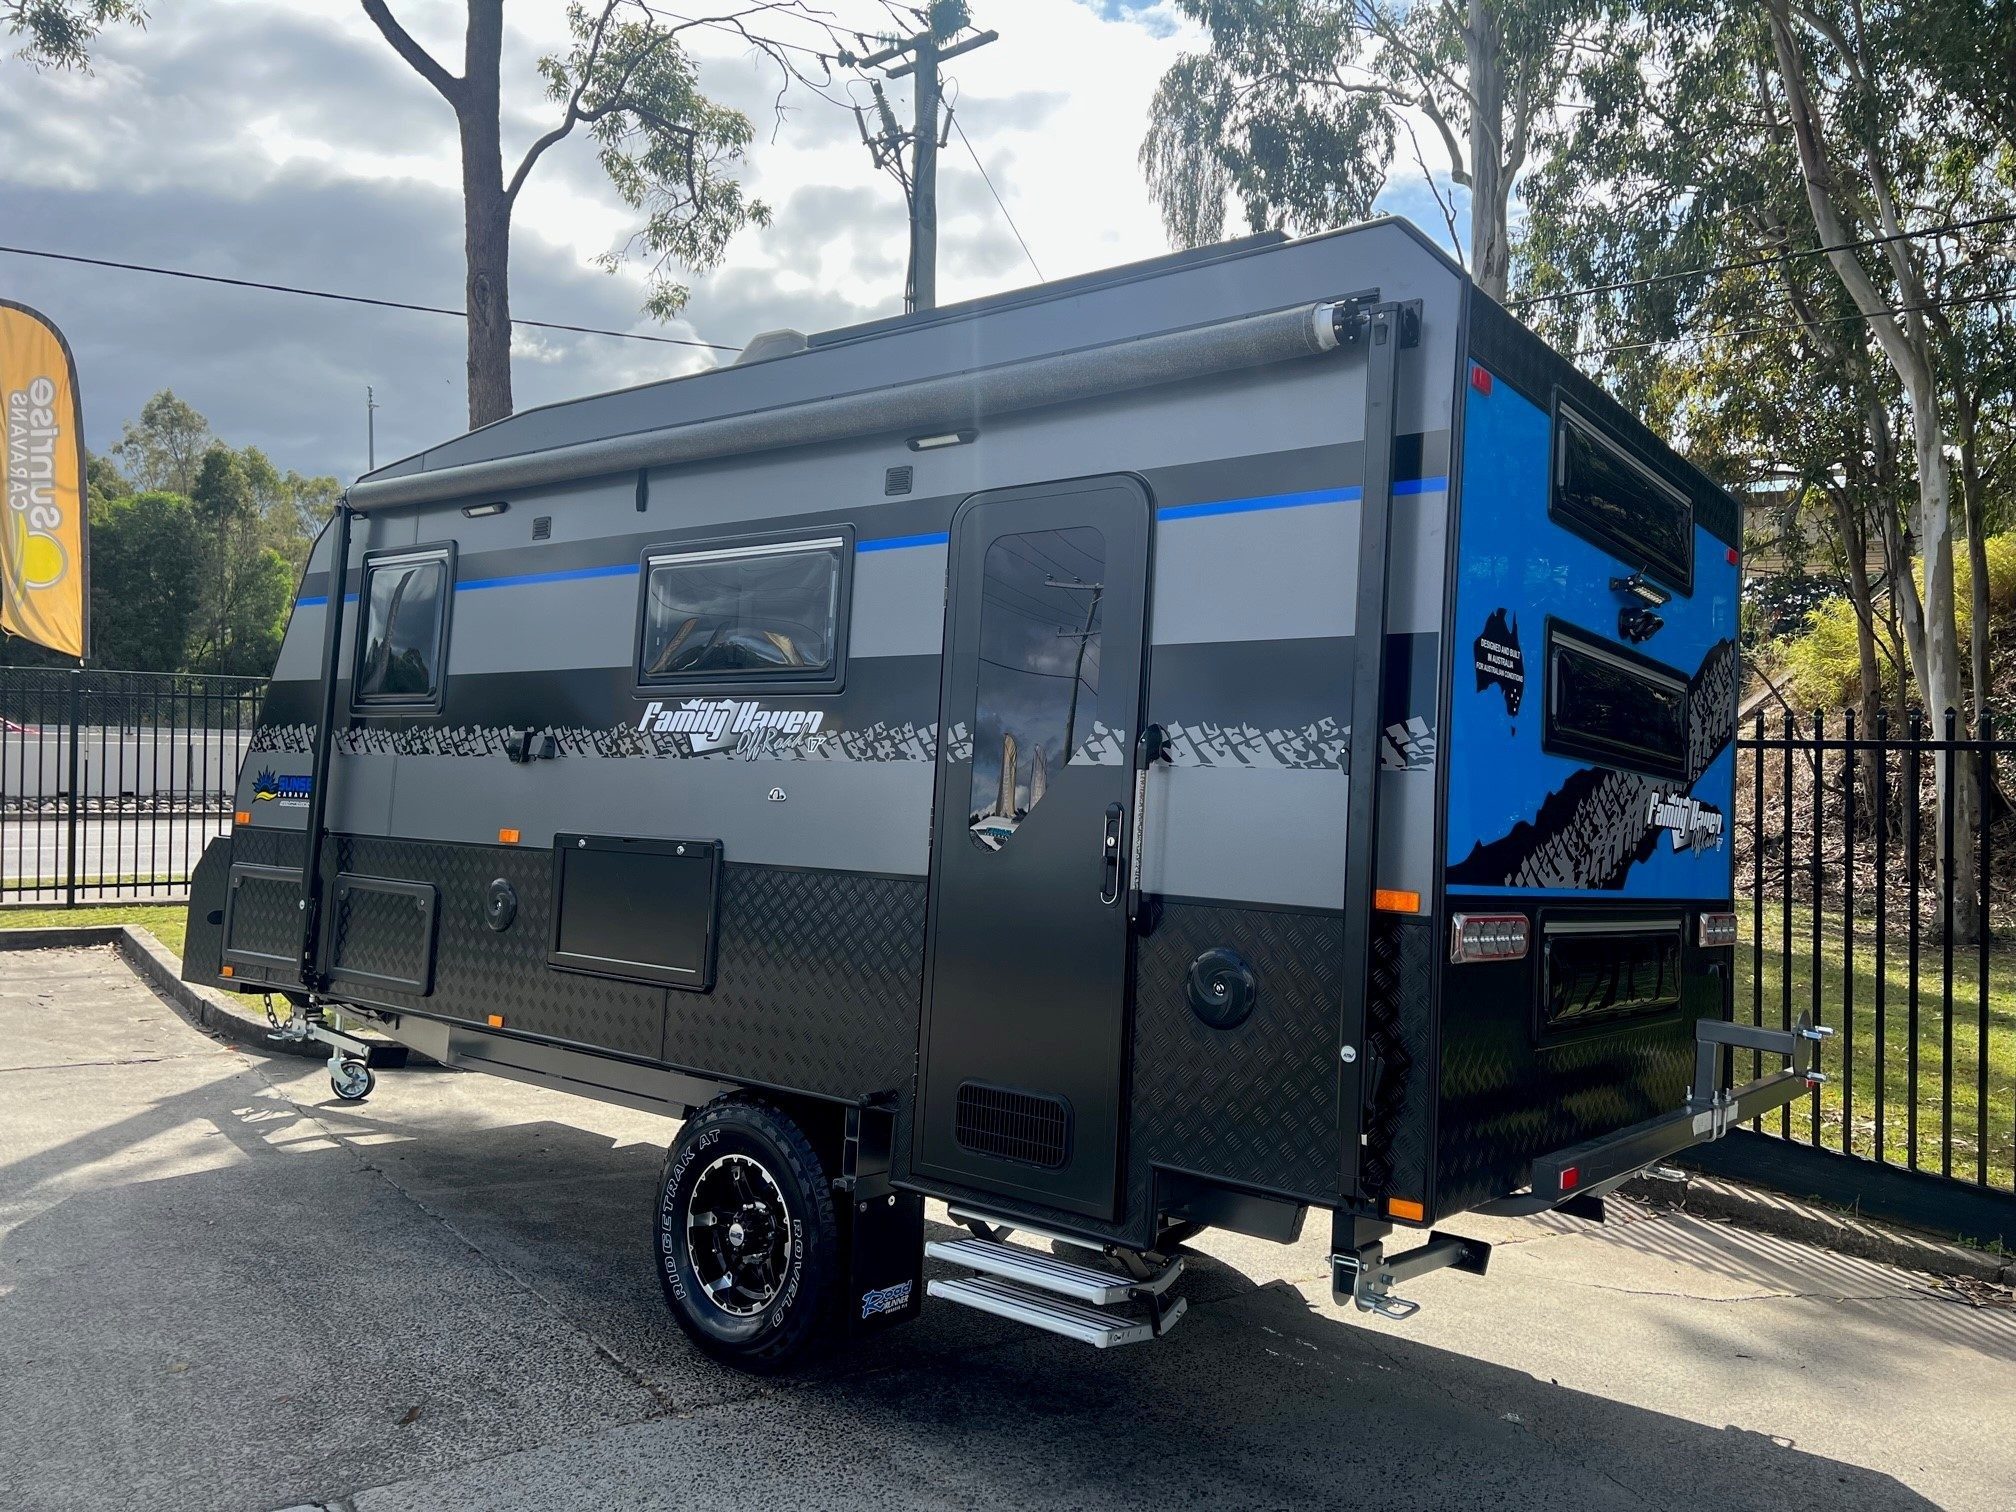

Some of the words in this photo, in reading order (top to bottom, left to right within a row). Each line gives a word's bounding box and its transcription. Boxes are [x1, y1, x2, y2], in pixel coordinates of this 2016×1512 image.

[1480, 638, 1501, 653] DESIGNED
[1501, 644, 1509, 656] AND
[1509, 648, 1520, 659] BUILT
[1476, 661, 1484, 670] FOR
[1484, 664, 1505, 677] AUSTRALIAN
[1504, 670, 1523, 683] CONDITIONS
[1487, 653, 1492, 662] IN
[1492, 655, 1514, 669] AUSTRALIA
[637, 701, 730, 742] Family
[731, 701, 824, 734] Haven
[279, 776, 312, 791] SUNSE
[277, 791, 309, 799] CARAVA
[1647, 792, 1689, 837] Family
[1689, 800, 1722, 835] Haven
[662, 1146, 695, 1300] RIDGETRAK
[699, 1129, 721, 1150] AT
[862, 1279, 913, 1319] Road
